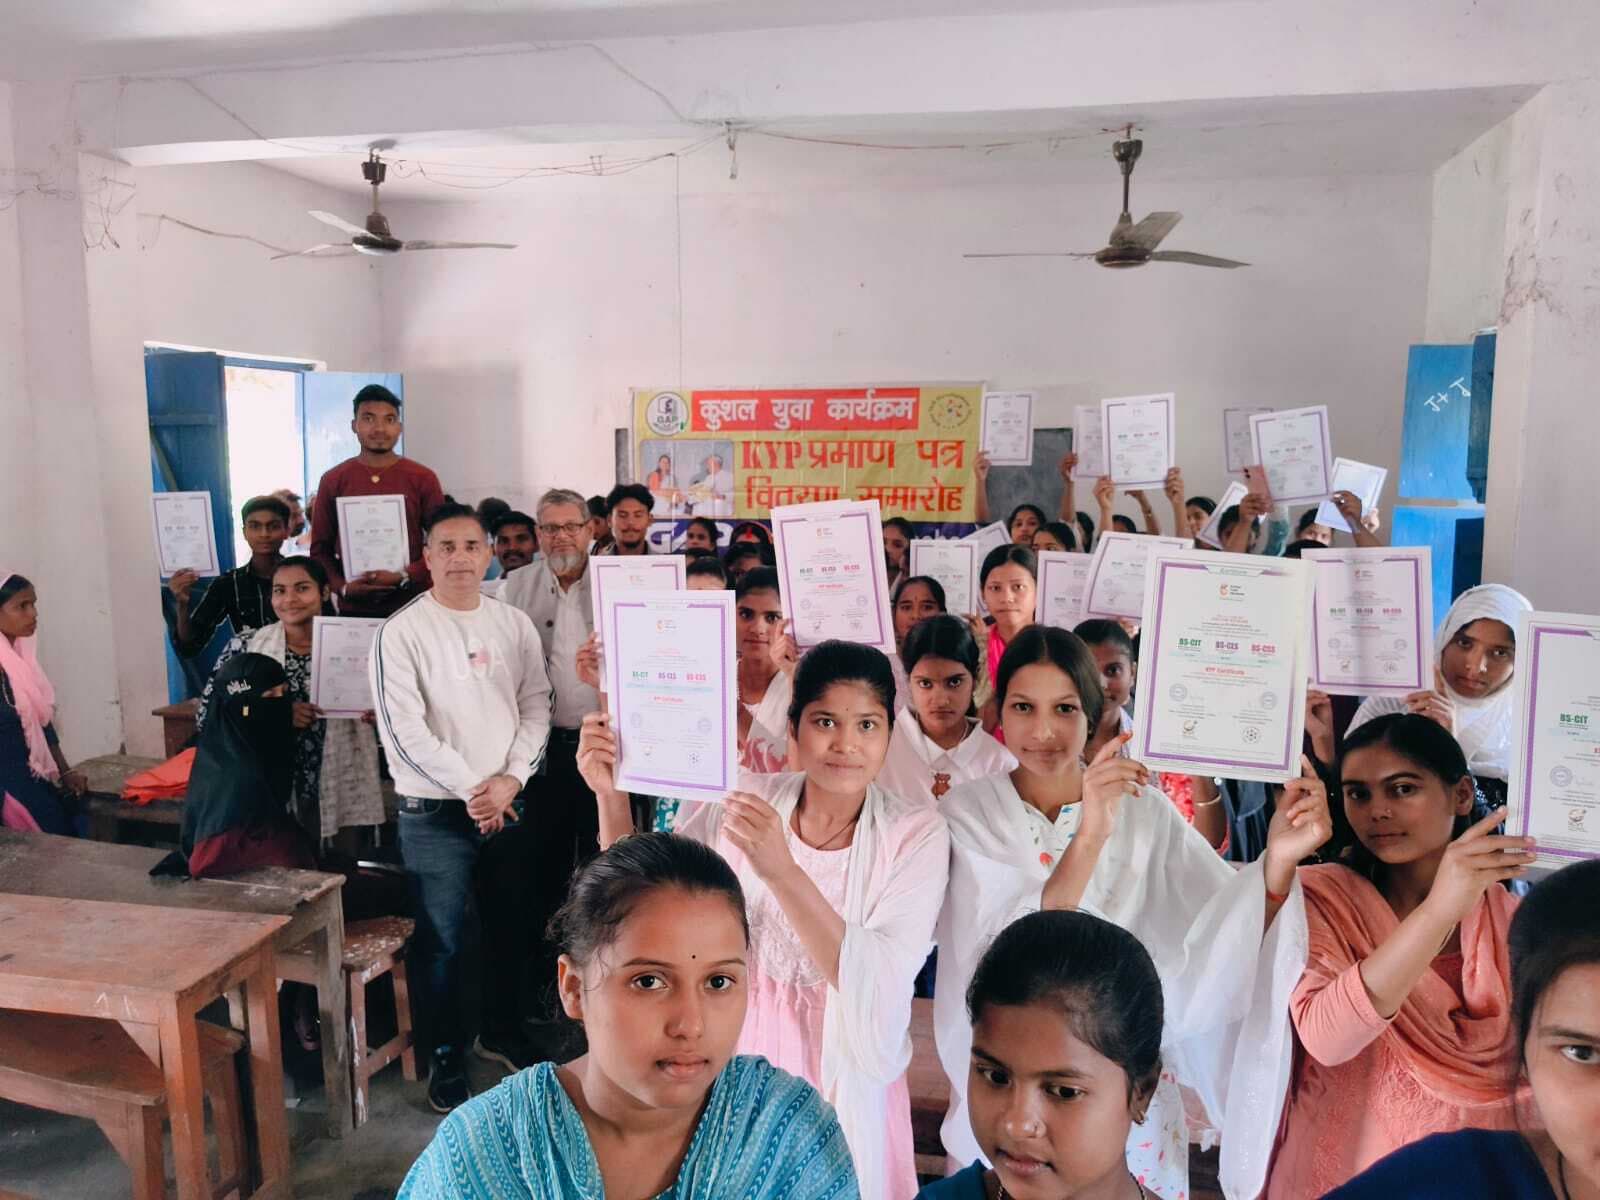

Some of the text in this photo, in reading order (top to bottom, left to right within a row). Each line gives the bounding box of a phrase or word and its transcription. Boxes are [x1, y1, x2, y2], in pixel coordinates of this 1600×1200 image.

[699, 398, 759, 430] कुशल
[770, 398, 814, 430] युवा
[826, 388, 917, 421] कार्यक्रम
[741, 439, 966, 469] KYP प्रमाण पत्र
